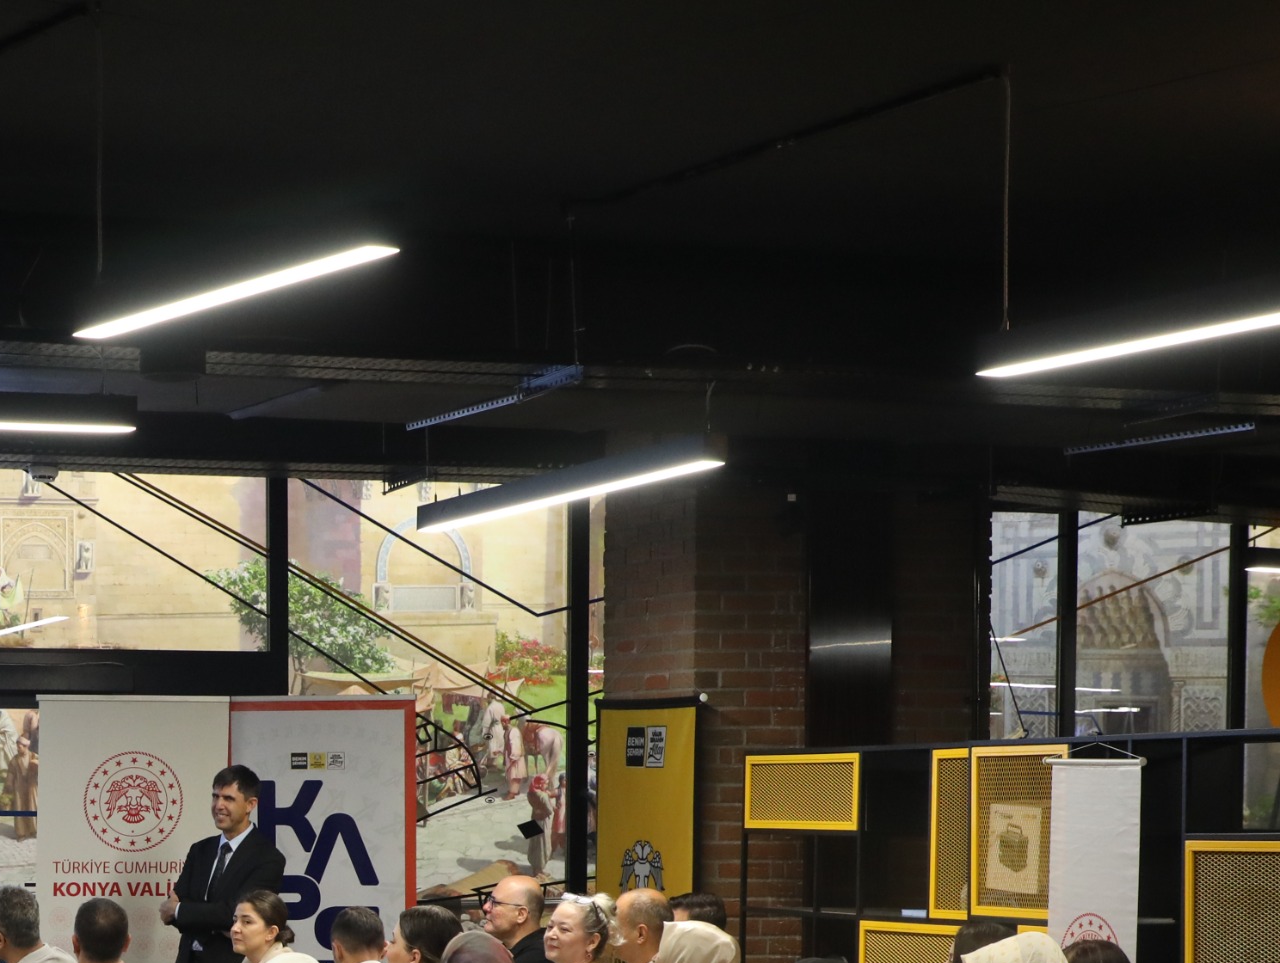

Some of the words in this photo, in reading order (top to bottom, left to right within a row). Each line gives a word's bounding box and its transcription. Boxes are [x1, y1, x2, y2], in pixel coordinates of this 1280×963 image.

[53, 859, 110, 874] TÜRKİYE
[114, 859, 187, 874] CUMHURİ
[53, 882, 122, 897] KONYA
[127, 879, 177, 897] VALİ
